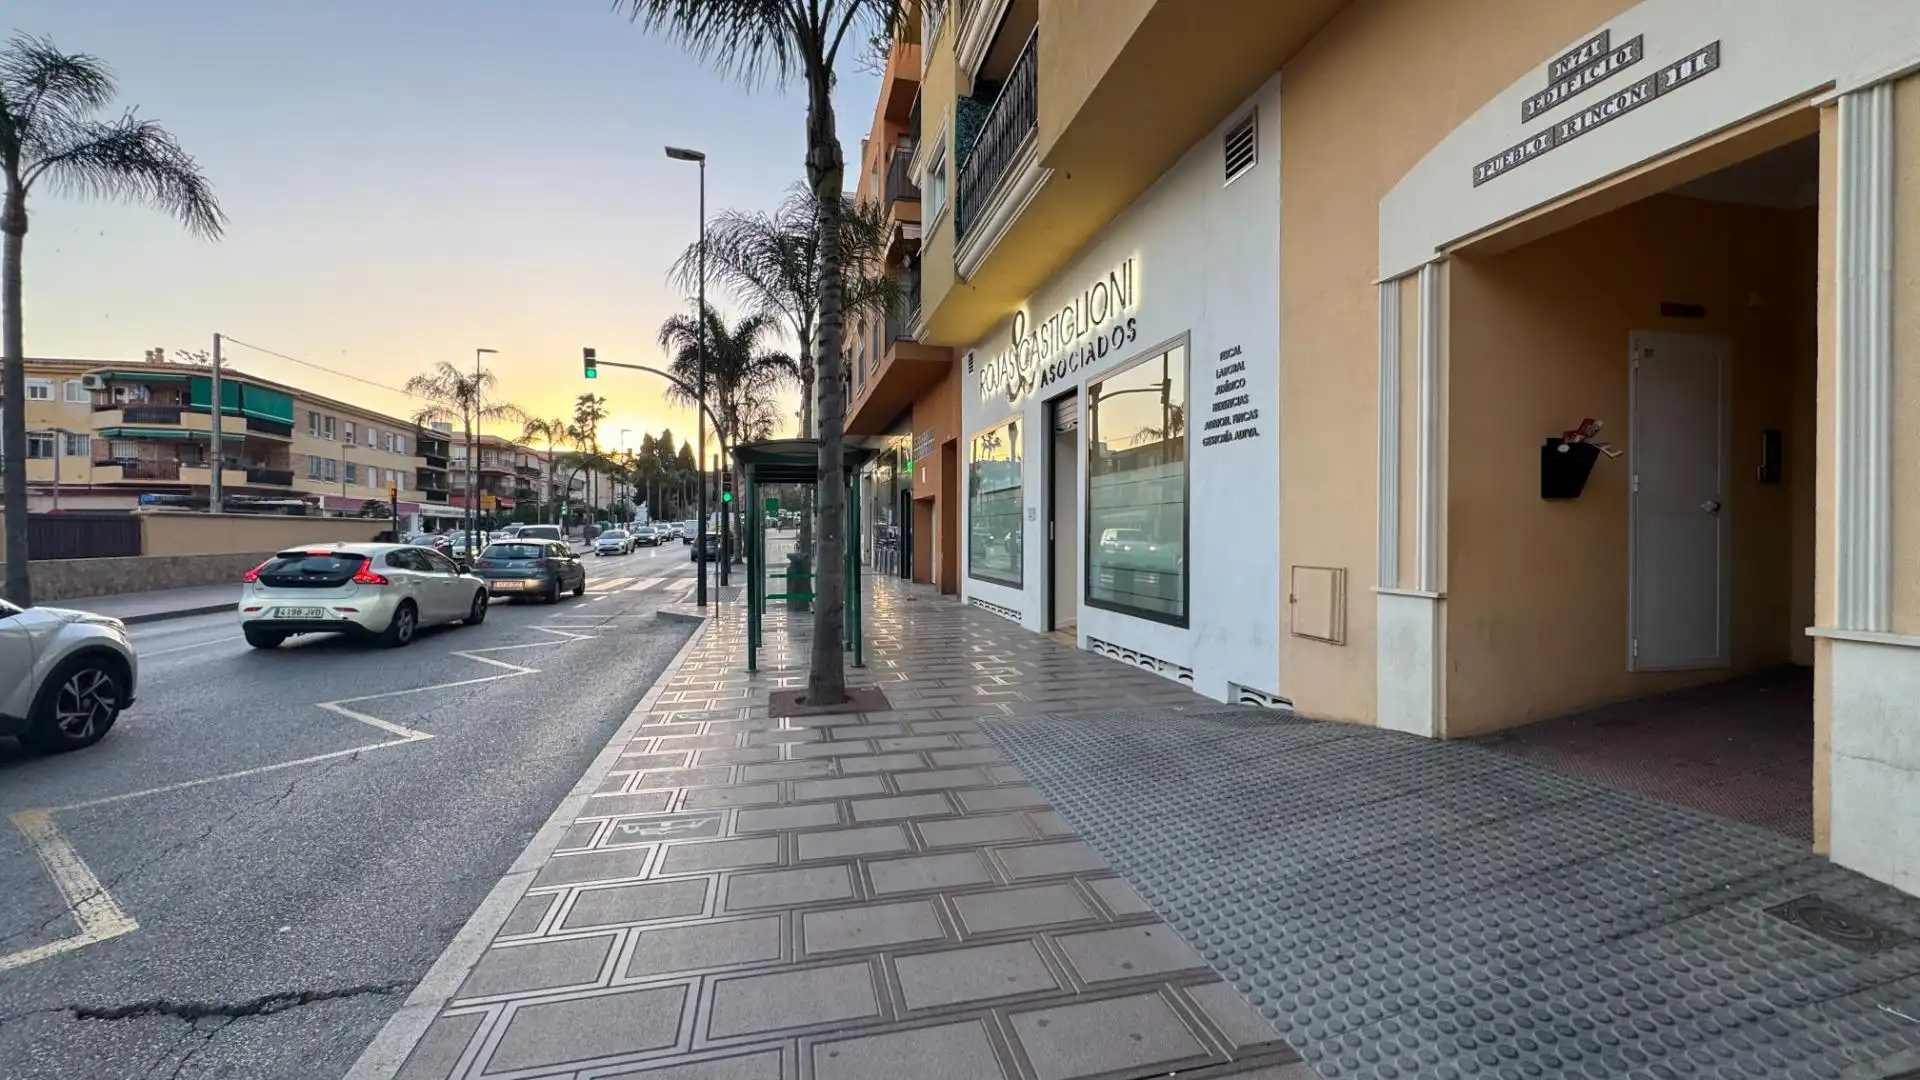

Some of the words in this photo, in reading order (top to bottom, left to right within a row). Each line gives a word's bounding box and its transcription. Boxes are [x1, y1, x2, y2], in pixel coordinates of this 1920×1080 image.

[1530, 46, 1631, 114] EDIFICIO
[1481, 136, 1546, 179] PUEBLO
[1563, 85, 1647, 138] RINCON
[980, 348, 1014, 398] ROJAS
[1019, 258, 1136, 372] CASTIGLIONI
[1040, 317, 1137, 389] ASOCIADOS
[1212, 394, 1250, 412] HERENCIAS
[1216, 361, 1246, 379] LABORAL
